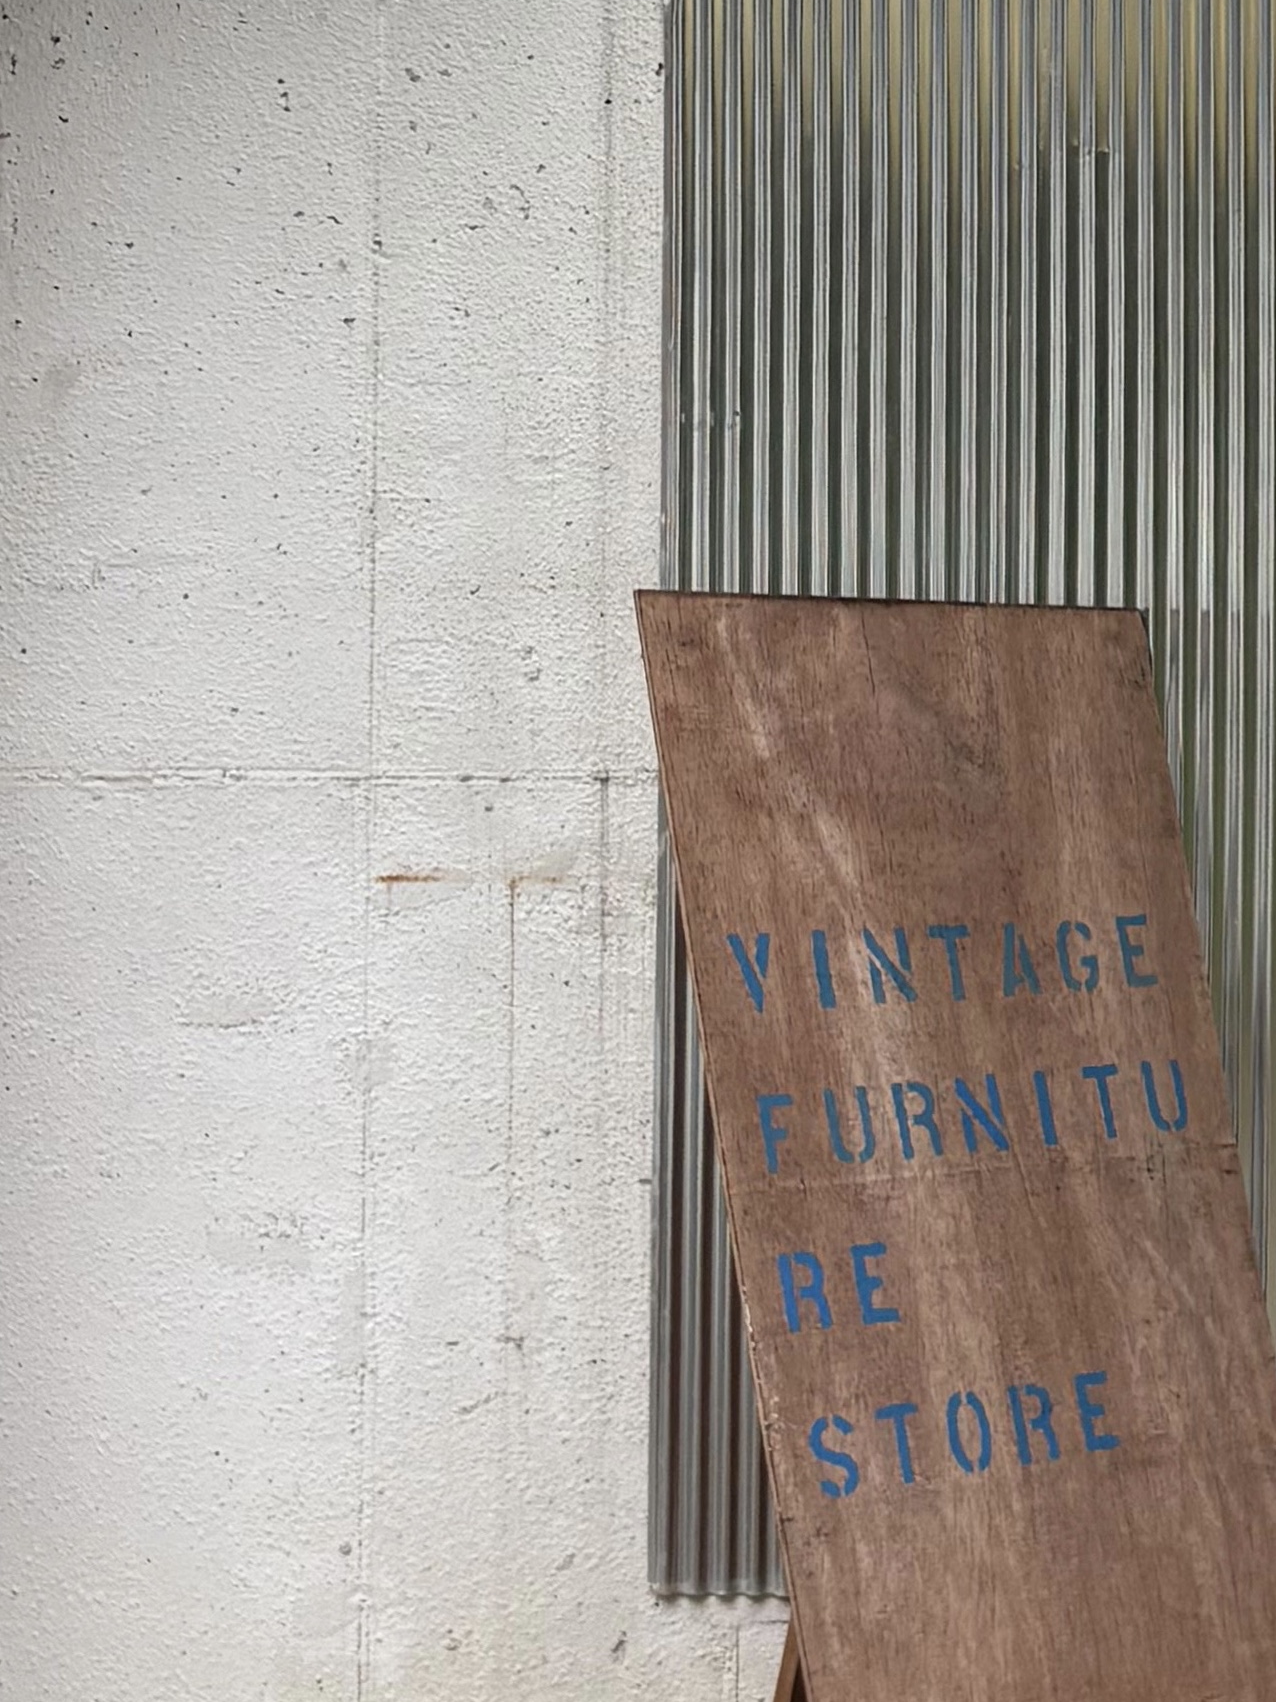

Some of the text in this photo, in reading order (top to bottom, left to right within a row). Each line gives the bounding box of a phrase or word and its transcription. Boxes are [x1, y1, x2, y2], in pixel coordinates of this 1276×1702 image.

[726, 913, 1157, 1013] VINTAGE
[756, 1060, 1189, 1174] FURNITU
[776, 1242, 901, 1335] RE
[808, 1370, 1121, 1499] STORE
